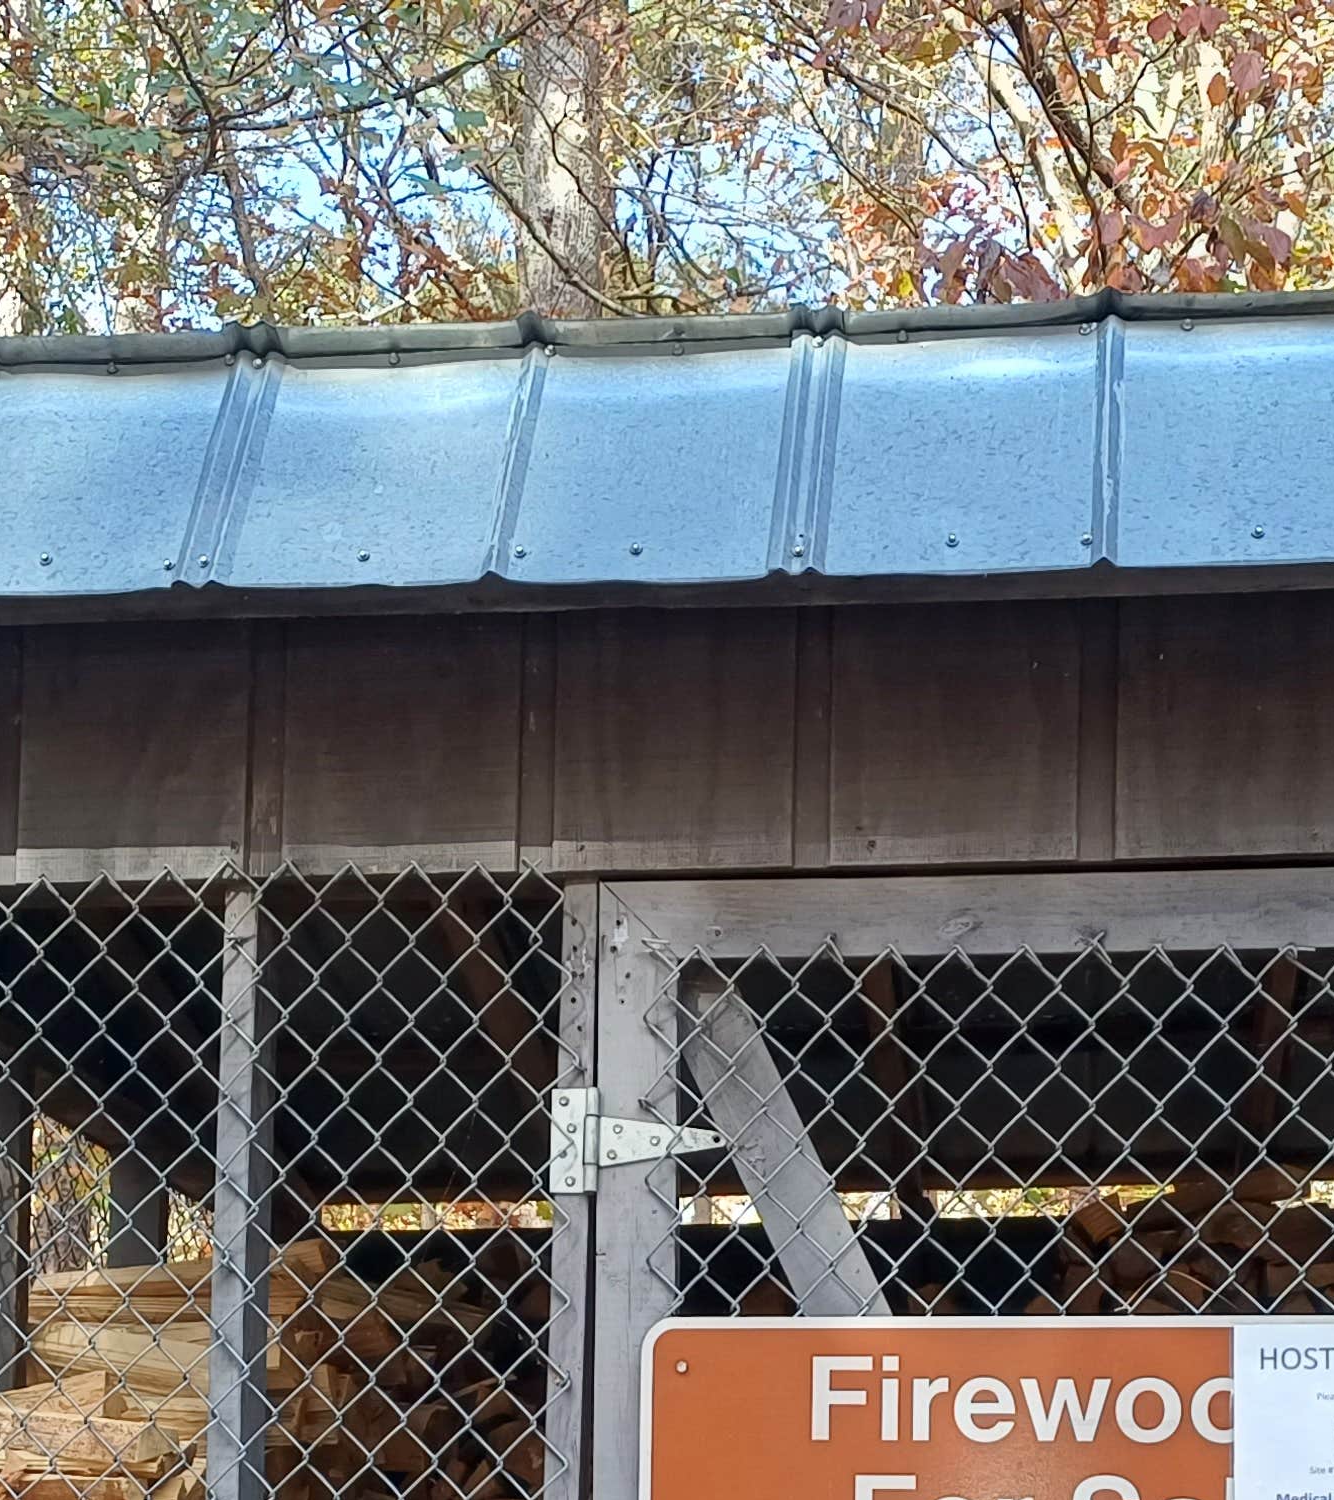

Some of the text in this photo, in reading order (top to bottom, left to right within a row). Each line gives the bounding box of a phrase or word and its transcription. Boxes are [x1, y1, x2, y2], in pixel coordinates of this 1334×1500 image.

[1259, 1347, 1334, 1370] HOST
[810, 1354, 1234, 1444] Firewoo
[1309, 1466, 1325, 1474] Site
